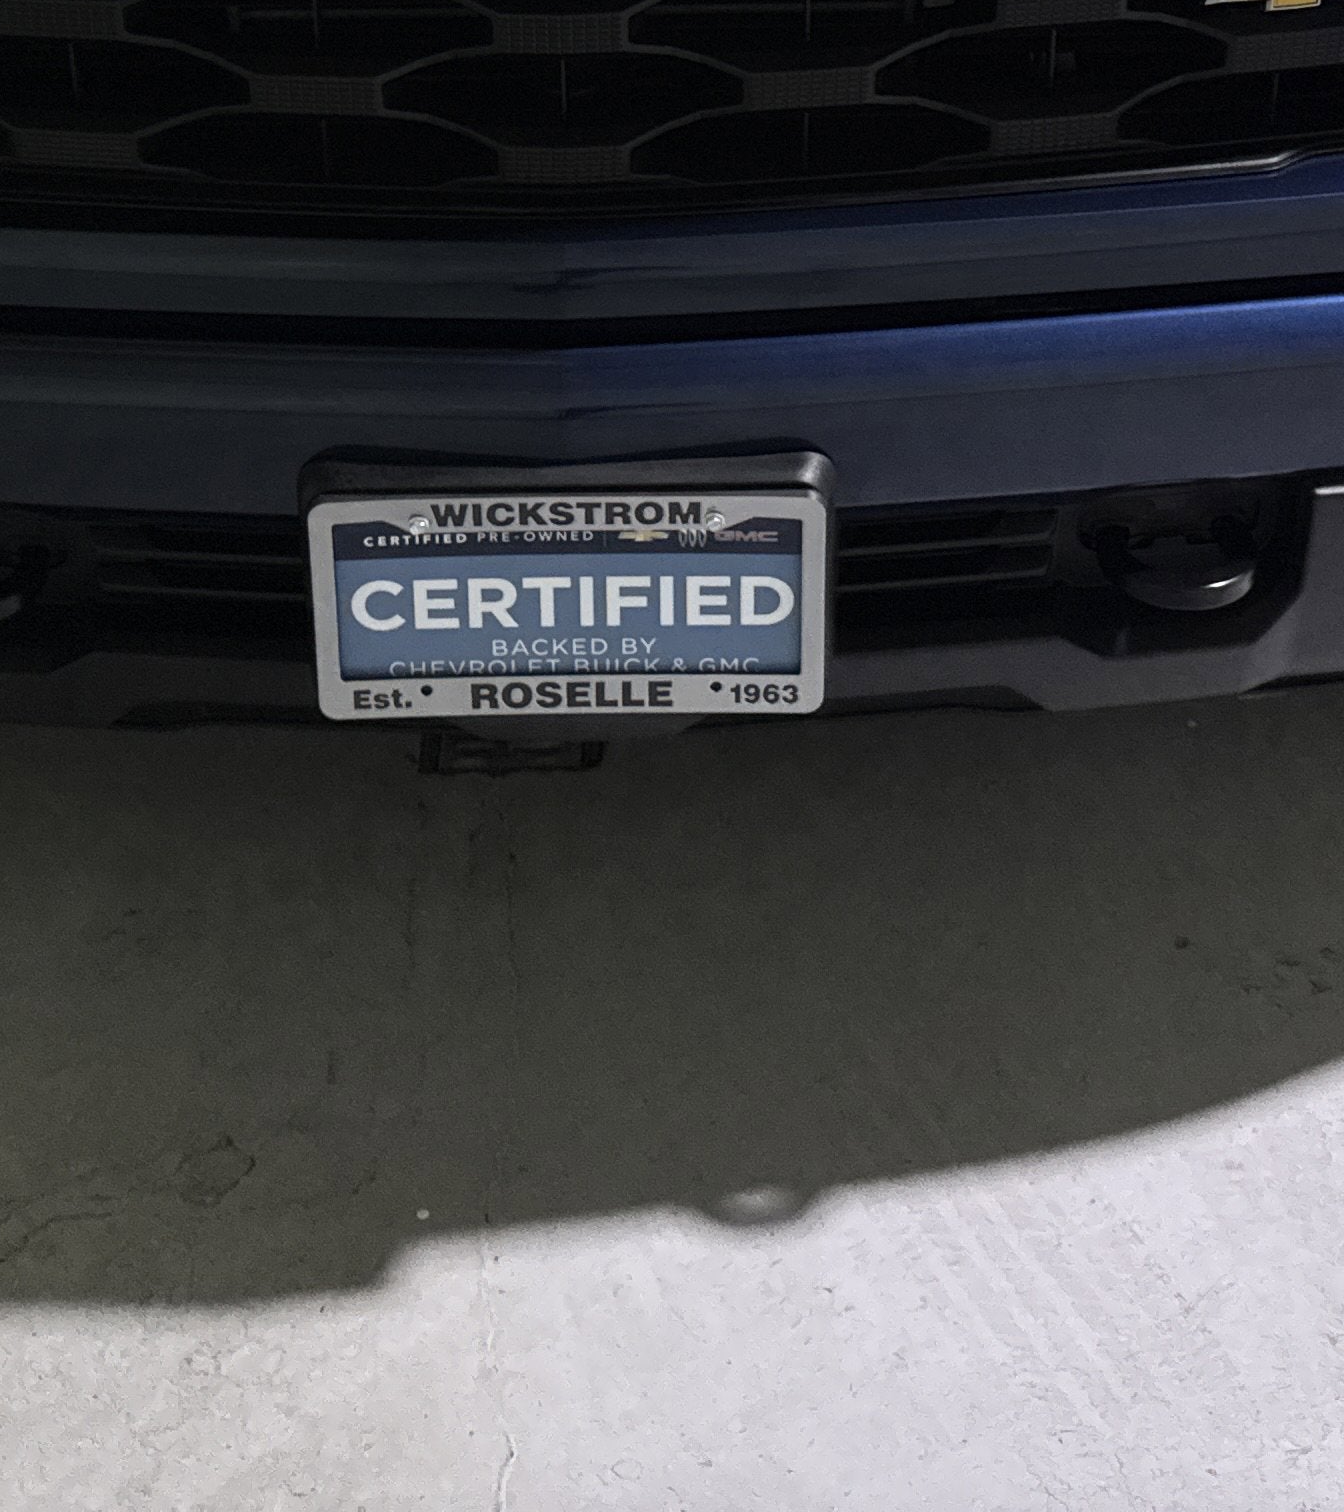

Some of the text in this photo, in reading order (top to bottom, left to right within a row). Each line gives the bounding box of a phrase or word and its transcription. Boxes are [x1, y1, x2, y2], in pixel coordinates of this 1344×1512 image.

[430, 501, 701, 527] WICKSTROM
[363, 531, 594, 548] CERTIFIED PRE-OWNED
[714, 530, 779, 543] GMC
[351, 575, 795, 632] CERTIFIED
[492, 637, 656, 657] BACKED BY
[353, 681, 799, 710] Est. ROSELLE 1963
